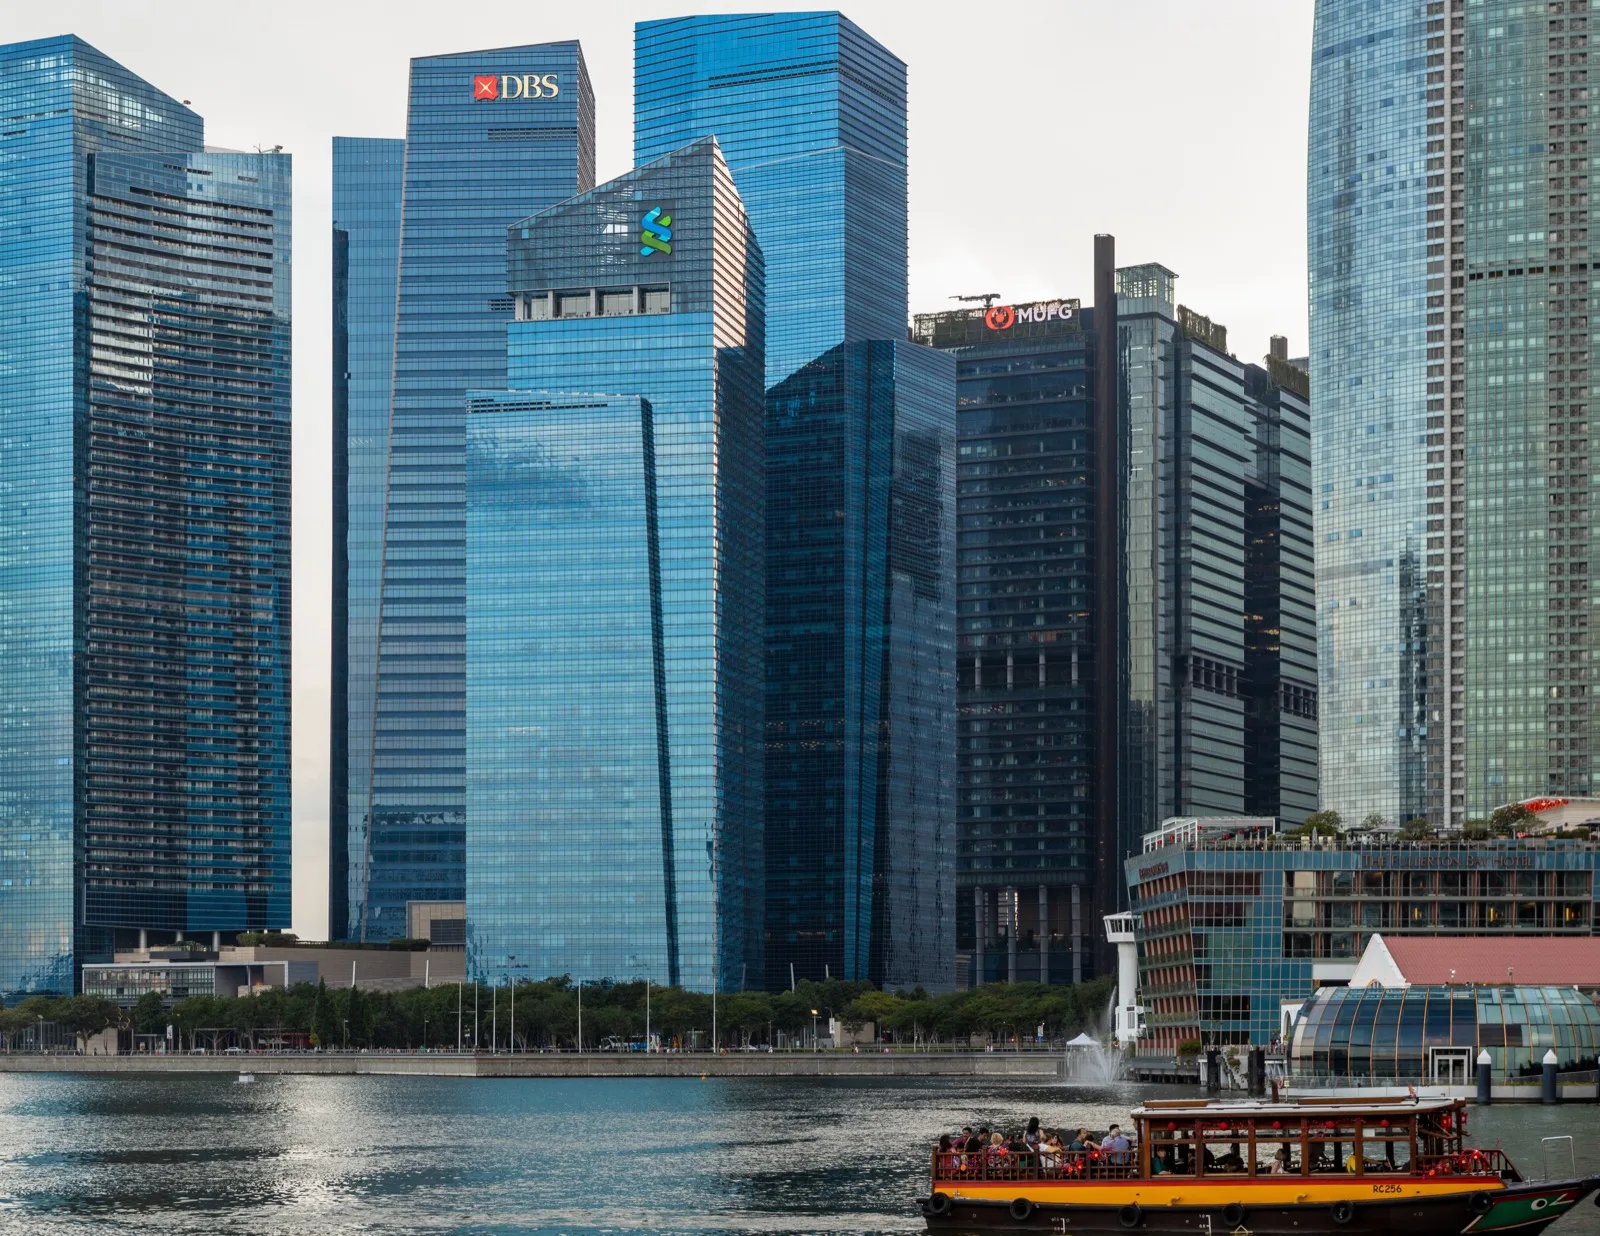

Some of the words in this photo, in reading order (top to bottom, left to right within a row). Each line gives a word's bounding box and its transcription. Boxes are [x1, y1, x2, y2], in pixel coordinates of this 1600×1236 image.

[501, 74, 559, 99] DBS
[1018, 303, 1073, 324] MUFG
[1364, 854, 1387, 867] THE
[1391, 854, 1461, 867] FULLERTON
[1466, 854, 1489, 867] BAY
[1492, 854, 1534, 867] HOTEL
[1373, 1184, 1402, 1193] RC256
